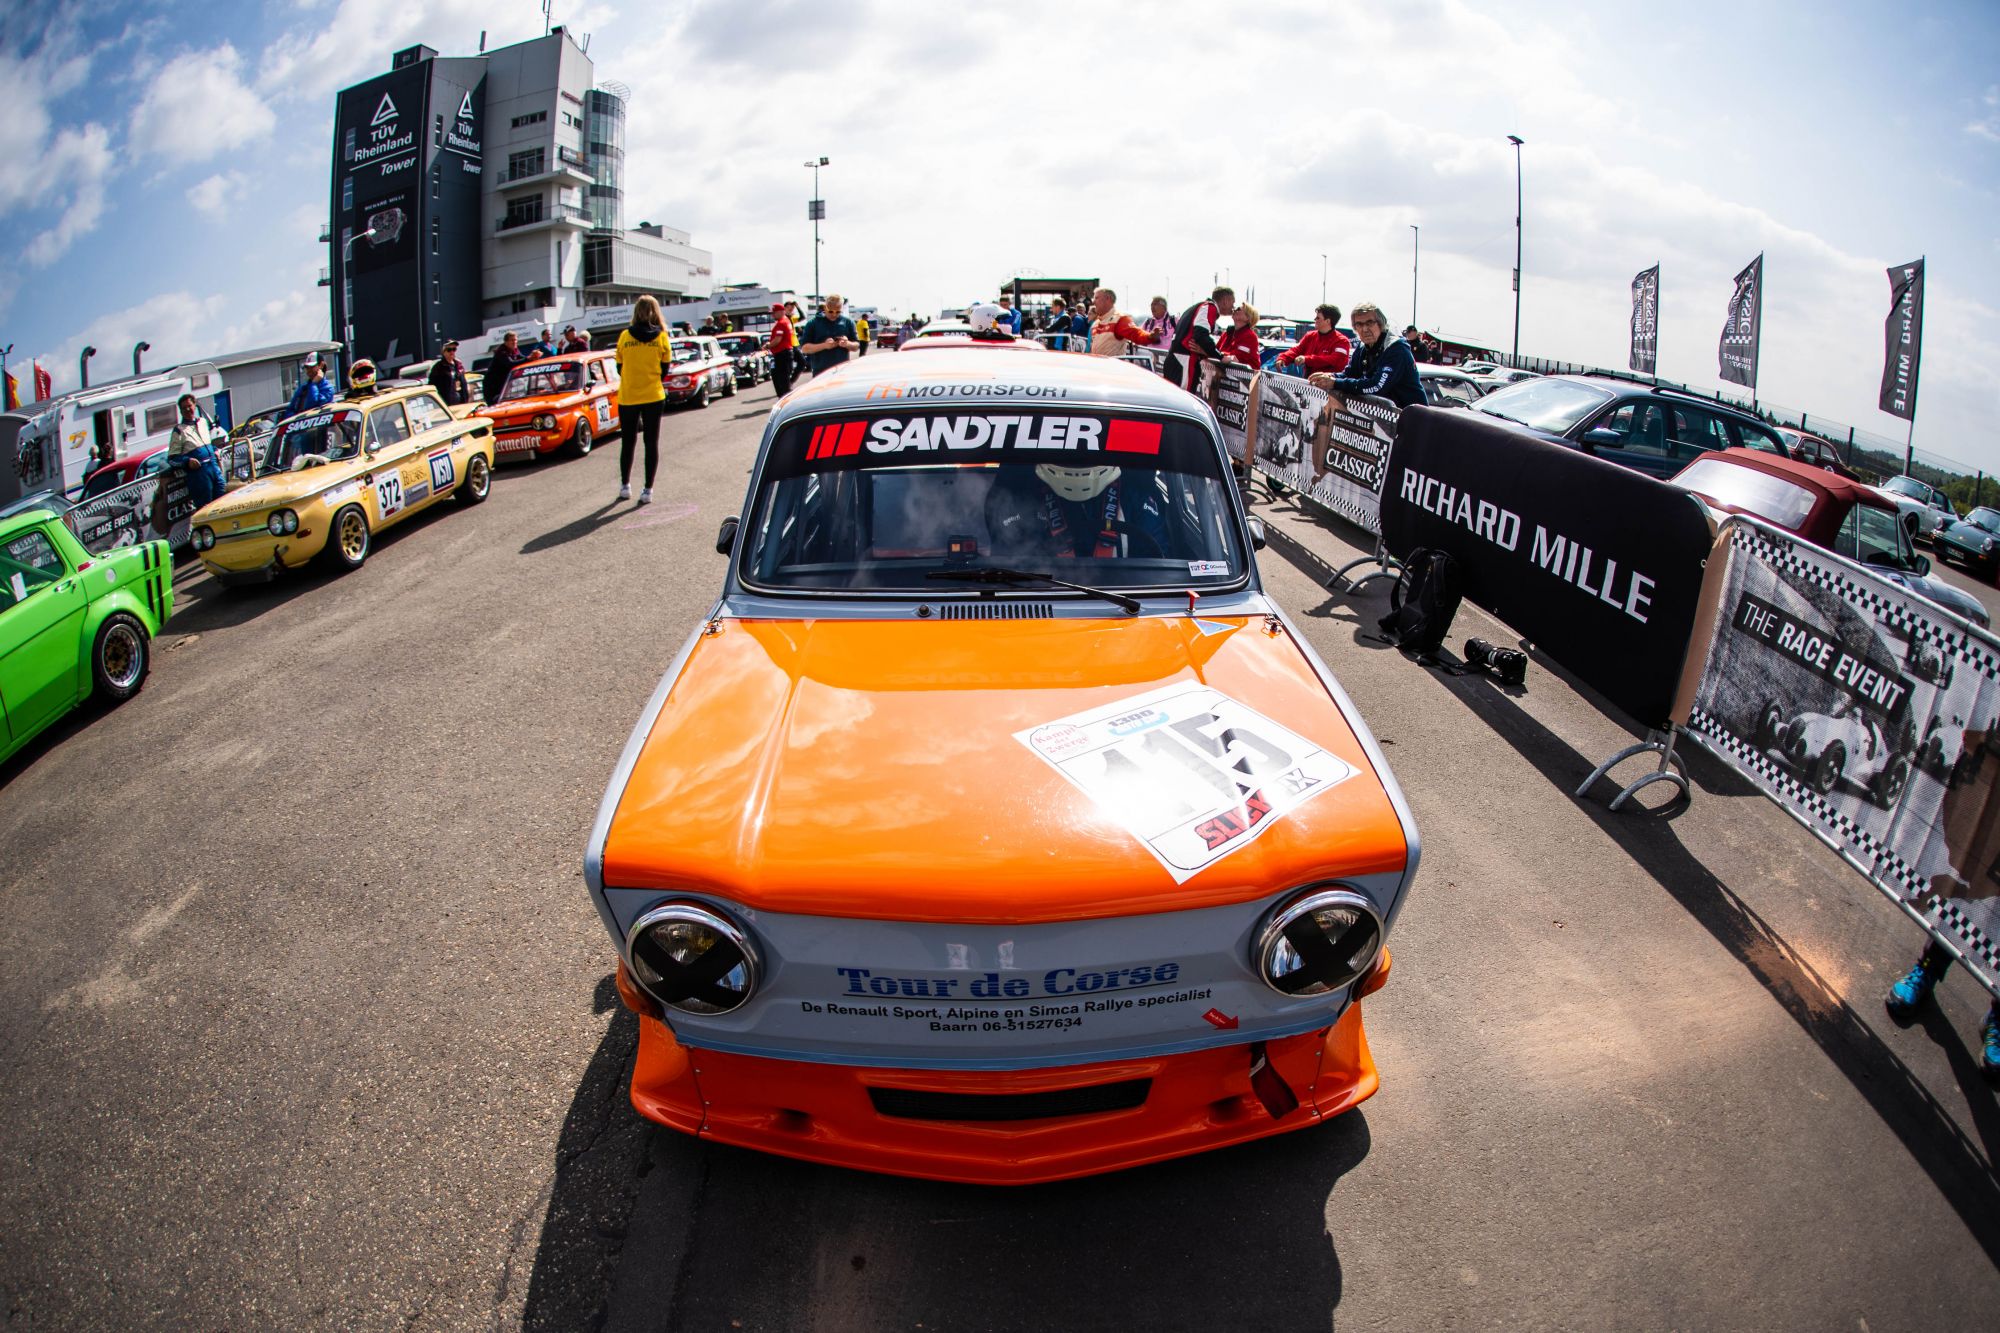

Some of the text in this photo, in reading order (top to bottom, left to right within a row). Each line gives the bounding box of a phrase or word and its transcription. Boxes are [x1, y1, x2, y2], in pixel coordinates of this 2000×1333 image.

[370, 123, 397, 142] TÜV
[458, 122, 473, 136] TÜV
[354, 132, 412, 161] Rheinland
[448, 132, 480, 152] Rheinland
[381, 157, 416, 176] Tower
[463, 160, 481, 174] Tower
[907, 384, 1069, 399] MOTORSPORT
[1362, 372, 1389, 394] MUSANG
[286, 413, 335, 434] SANDTLER
[1216, 406, 1242, 425] CLASSIC
[1263, 403, 1300, 425] THE RACE EVENT
[1335, 411, 1371, 430] RICHARD MILLE
[866, 415, 1102, 453] SANDTLER
[1331, 424, 1379, 457] NÜRBURGRING
[1326, 448, 1376, 484] CLASSIC
[379, 478, 402, 509] 372
[84, 511, 134, 544] THE RACE EVENT
[1400, 467, 1656, 624] RICHARD MILLE
[1741, 601, 1906, 712] THE RACE EVENT
[837, 962, 1180, 998] Tour de Corse
[801, 988, 1211, 1021] De Renault Sport, Alpine en Simca Rallye specialist
[930, 1017, 1082, 1032] Baarn 06-51527634
